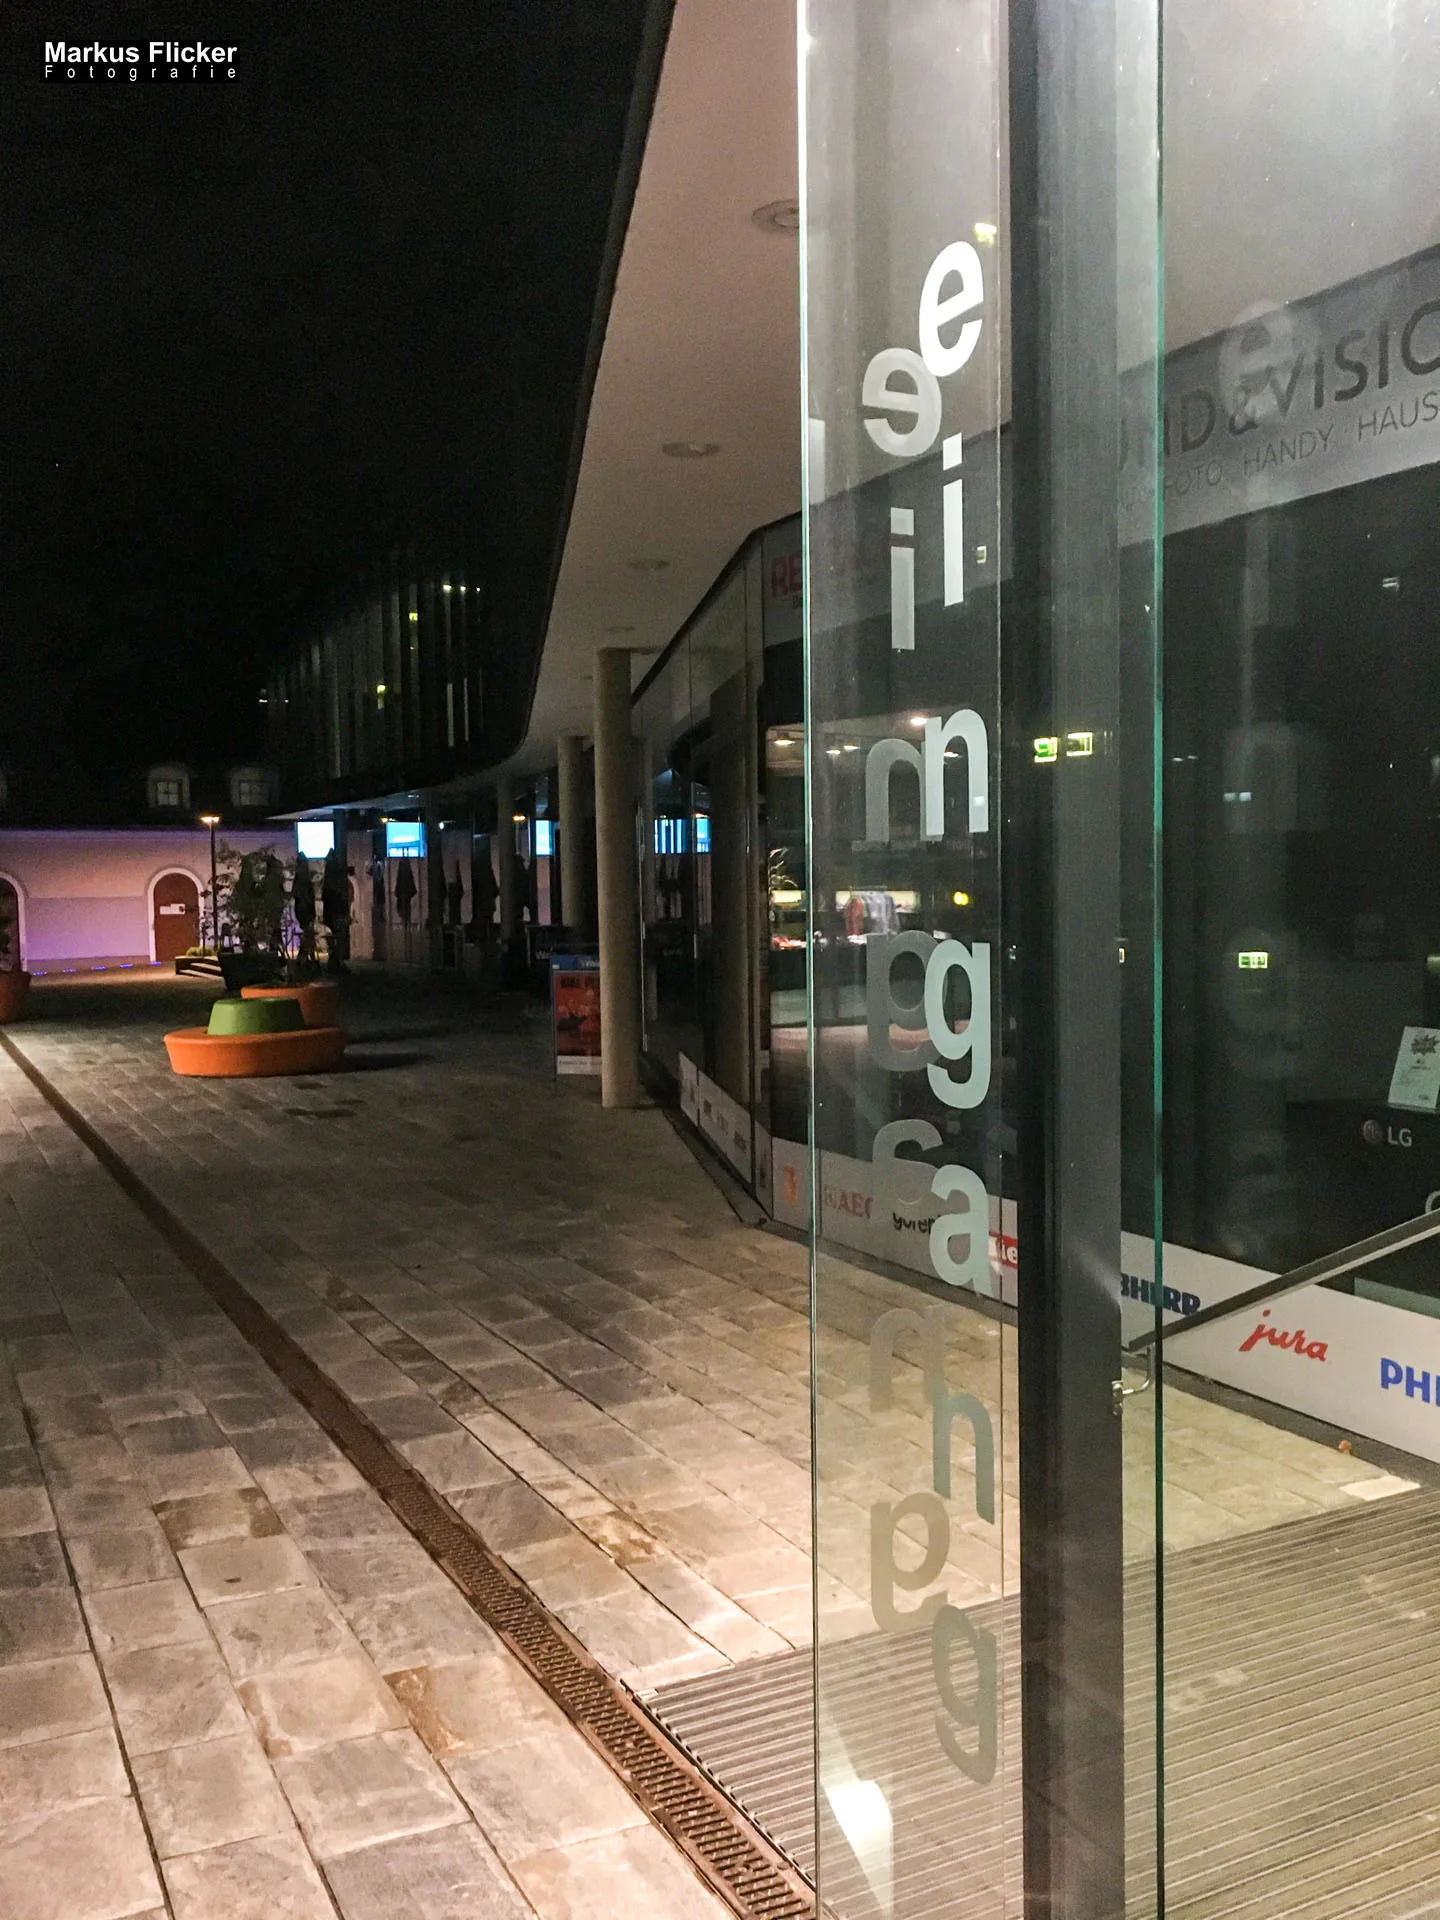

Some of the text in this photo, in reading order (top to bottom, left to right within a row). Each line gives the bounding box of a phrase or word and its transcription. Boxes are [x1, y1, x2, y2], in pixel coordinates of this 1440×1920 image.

[1243, 423, 1335, 476] HANDY
[1386, 1125, 1413, 1148] LG
[1238, 1308, 1330, 1363] jura
